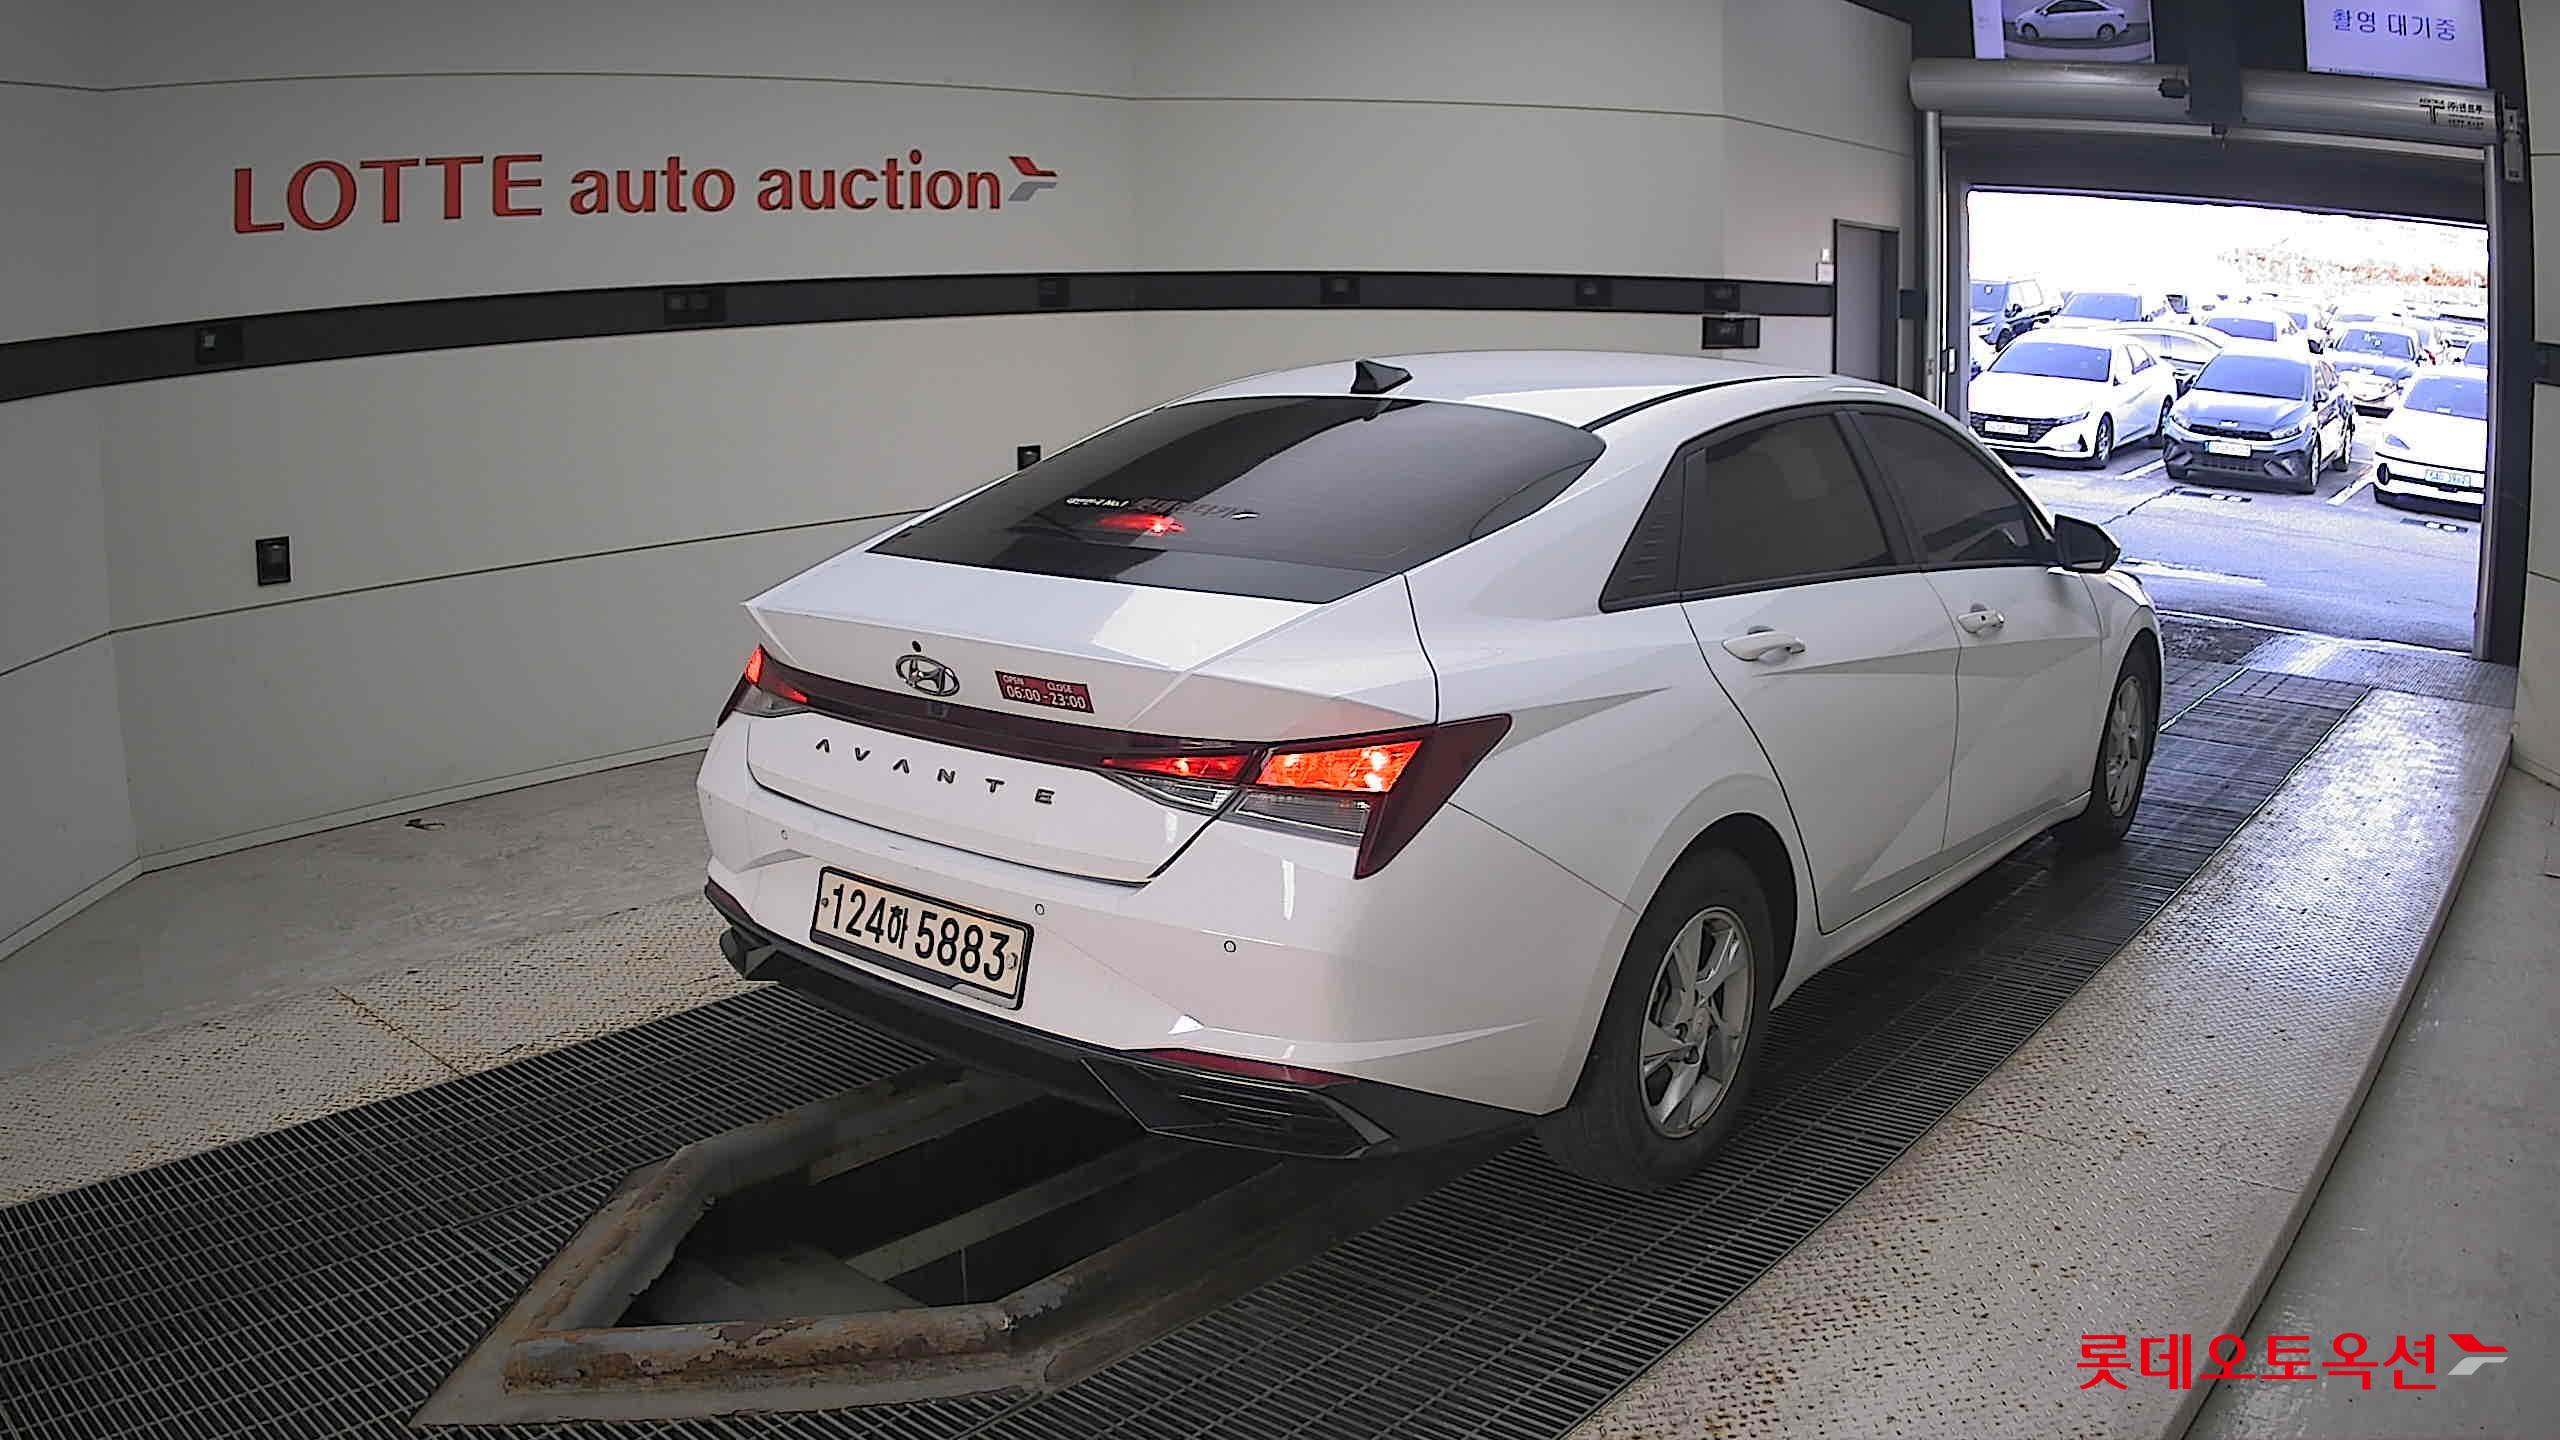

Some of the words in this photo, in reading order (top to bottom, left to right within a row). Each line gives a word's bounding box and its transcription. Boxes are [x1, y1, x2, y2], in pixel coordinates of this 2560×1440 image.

[2334, 9, 2376, 33] 촬영
[2387, 14, 2456, 41] 대기중
[234, 153, 543, 233] LOTTE
[569, 156, 736, 214] auto
[757, 149, 1001, 211] auction
[1047, 682, 1073, 694] CLOSE
[816, 738, 1055, 804] AVANTE
[914, 911, 1009, 981] 5883
